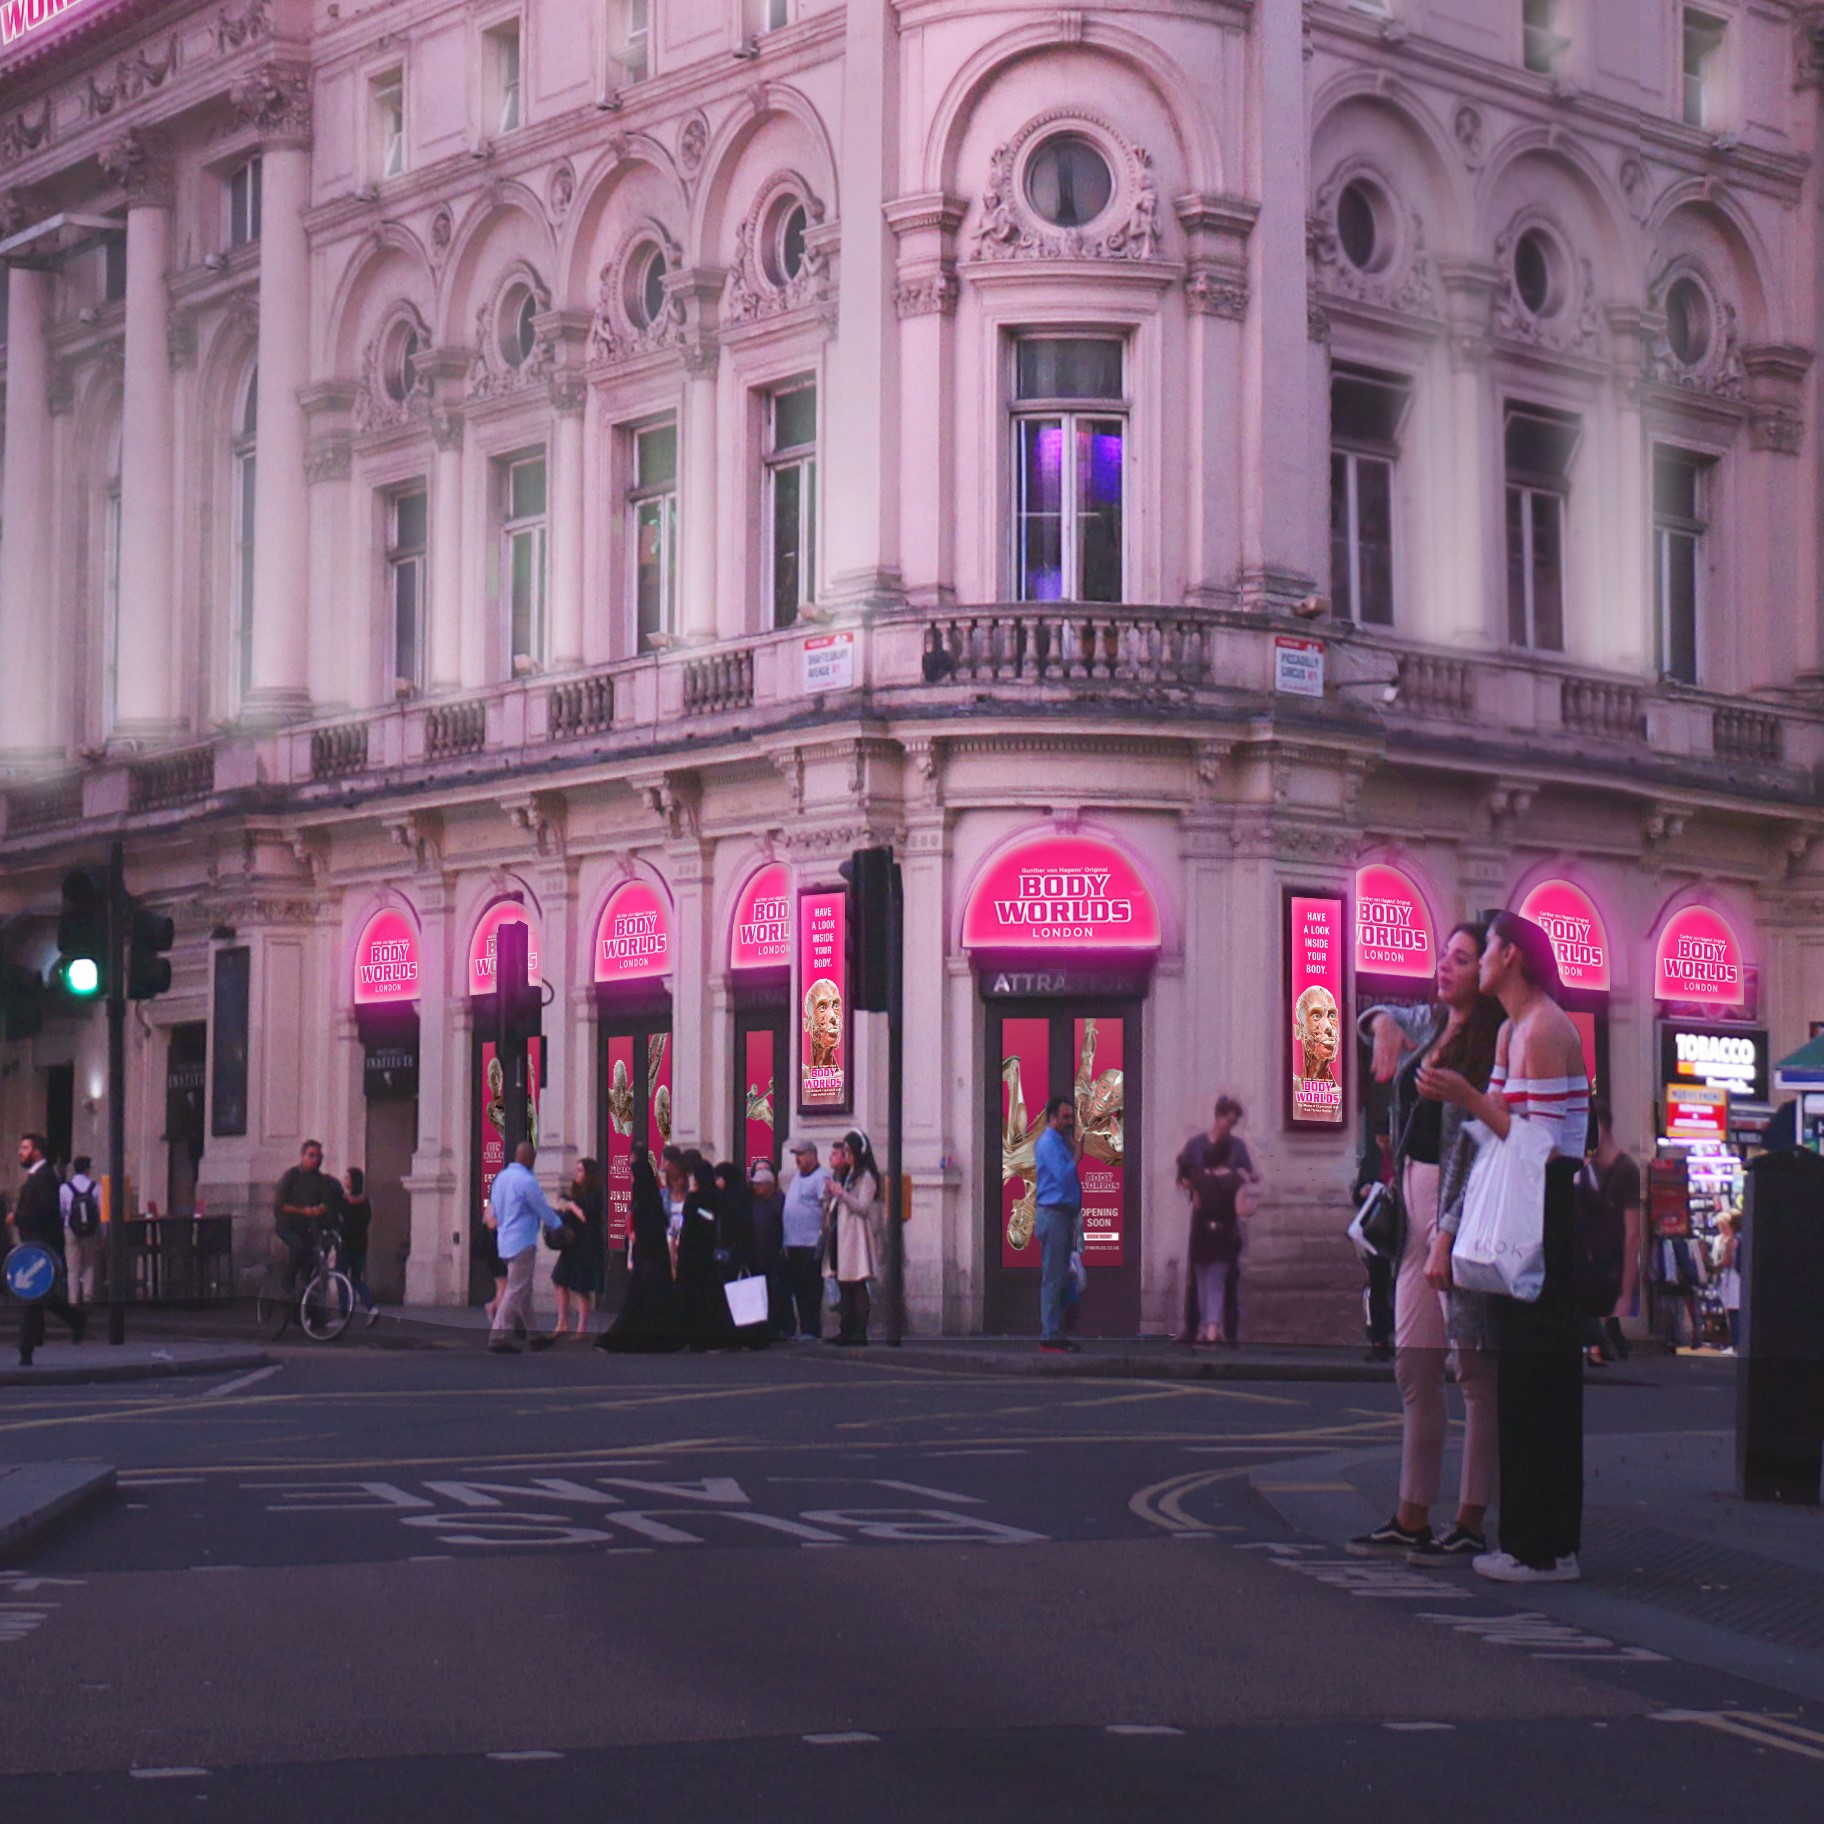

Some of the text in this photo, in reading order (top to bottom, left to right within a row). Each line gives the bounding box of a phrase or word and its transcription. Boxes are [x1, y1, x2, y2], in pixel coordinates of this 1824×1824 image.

[1019, 874, 1111, 898] BODY
[753, 901, 790, 922] BOD
[814, 907, 831, 917] HAVE
[994, 900, 1132, 924] WORLDS
[1307, 912, 1326, 922] HAVE
[1356, 902, 1413, 927] BODY
[615, 915, 657, 938] BODY
[811, 920, 835, 930] A LOOK
[1303, 925, 1330, 935] A LOOK
[1538, 916, 1591, 944] BODY
[740, 921, 790, 945] WORL
[813, 933, 834, 943] INSIDE
[1033, 927, 1093, 938] LONDON
[602, 933, 667, 959] WORLDS
[1305, 938, 1329, 949] INSIDE
[371, 944, 410, 964] BODY
[815, 946, 832, 955] YOUR
[1364, 949, 1405, 963] LONDON
[1550, 941, 1603, 967] RLDS
[1678, 939, 1727, 962] BODY
[1307, 951, 1327, 962] YOUR
[619, 958, 649, 969] LONDON
[1306, 964, 1328, 974] BODY.
[360, 962, 417, 983] WORLDS
[1559, 966, 1582, 977] NDON
[1664, 958, 1737, 983] WORLDS
[375, 984, 402, 993] LONDON
[1684, 982, 1718, 992] LONDON
[1675, 1033, 1755, 1065] TOBACCO
[811, 1068, 836, 1078] BODY
[804, 1077, 843, 1089] WORLDS
[1304, 1081, 1332, 1092] BODY
[1295, 1091, 1340, 1104] WORLDS
[1081, 1207, 1118, 1217] OPENING
[1087, 1218, 1111, 1227] SOON
[399, 1508, 1053, 1545] BUS
